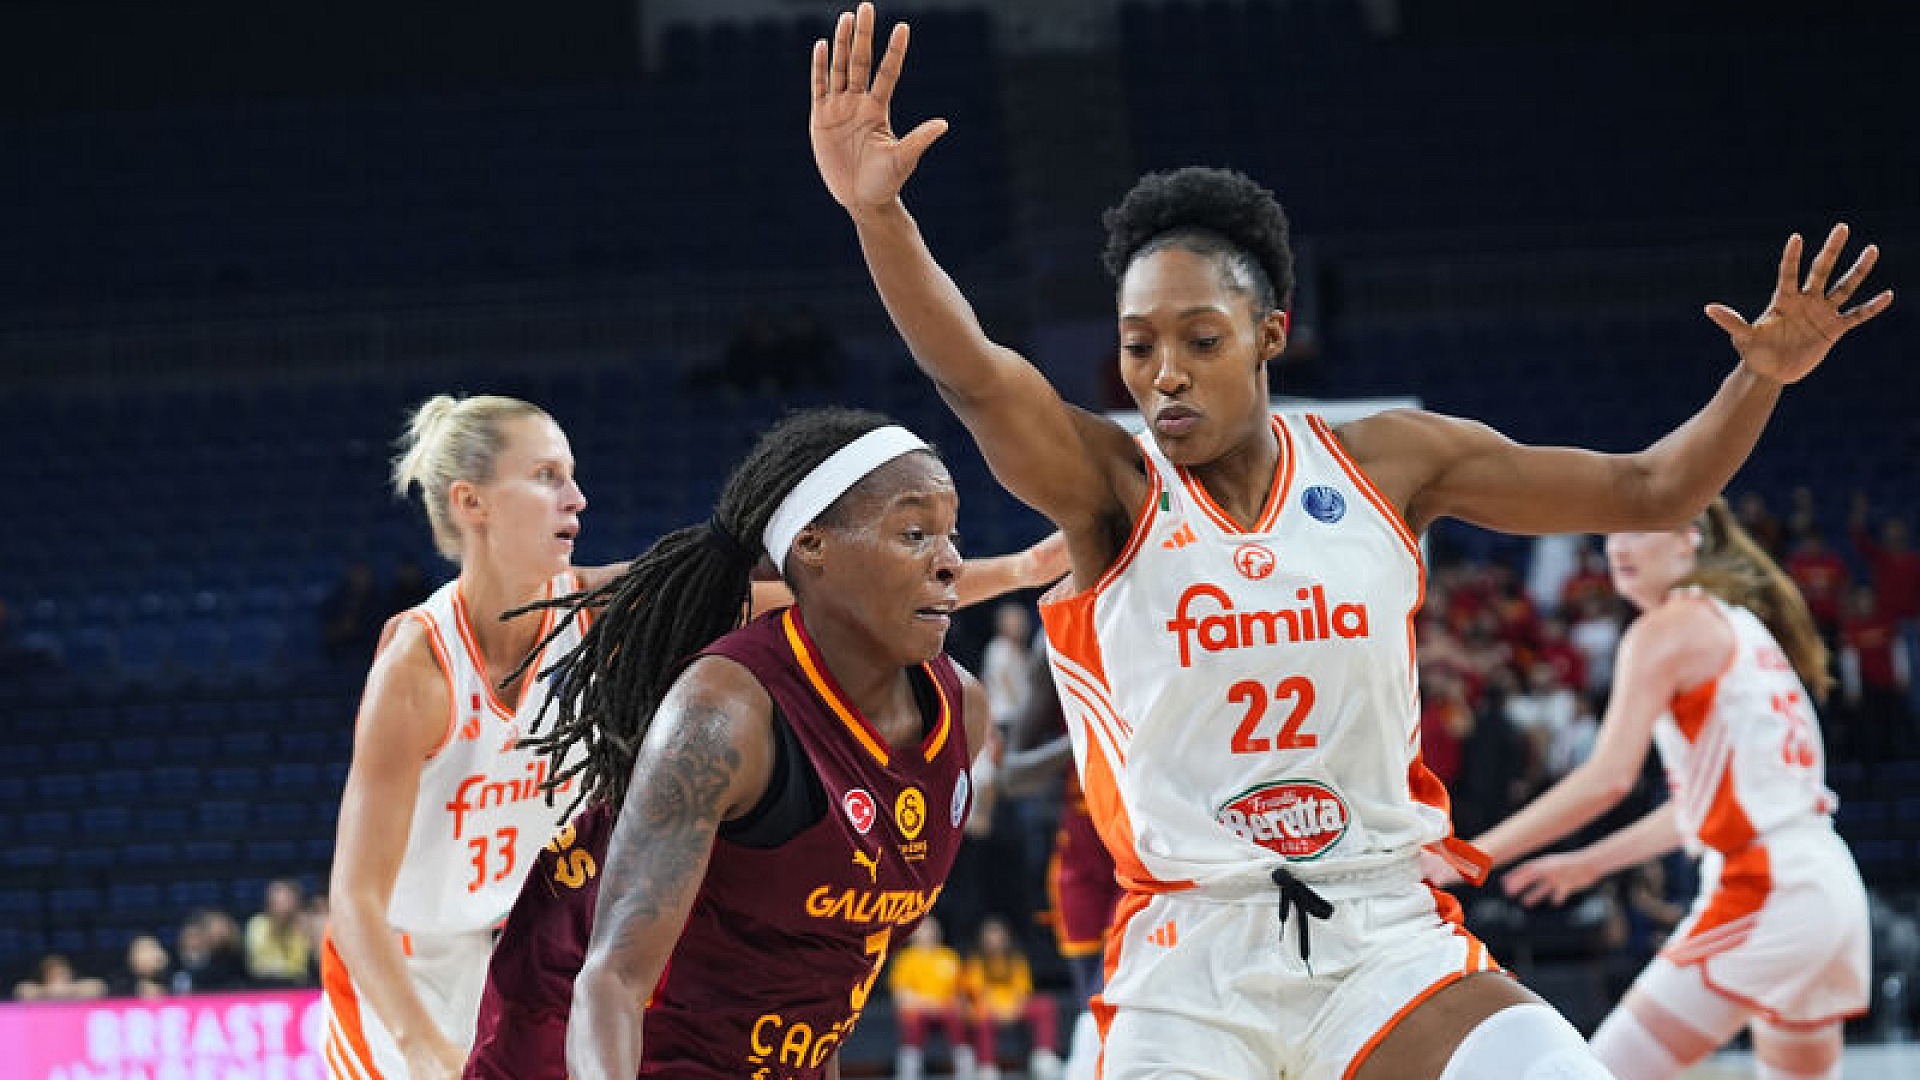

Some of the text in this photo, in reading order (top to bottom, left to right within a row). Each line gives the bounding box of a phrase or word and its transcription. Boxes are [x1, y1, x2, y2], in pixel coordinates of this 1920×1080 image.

[1166, 583, 1369, 668] famila
[1226, 676, 1318, 755] 22
[1219, 796, 1345, 842] Beretta
[467, 826, 519, 894] 33
